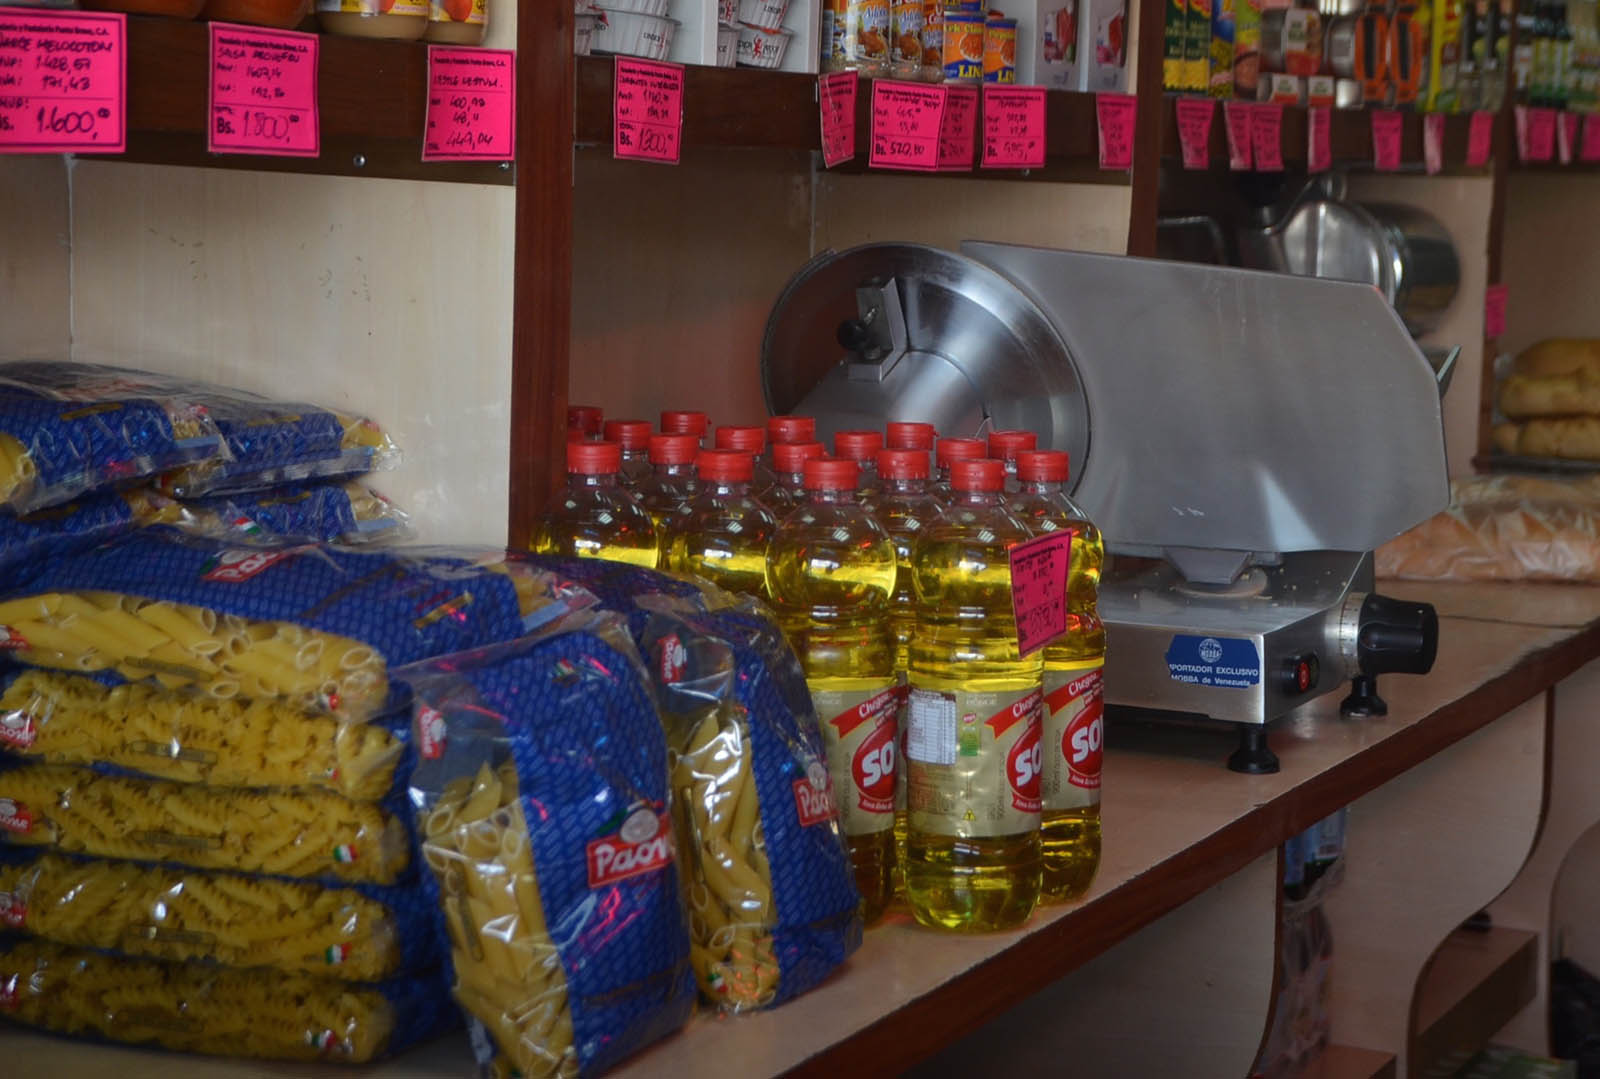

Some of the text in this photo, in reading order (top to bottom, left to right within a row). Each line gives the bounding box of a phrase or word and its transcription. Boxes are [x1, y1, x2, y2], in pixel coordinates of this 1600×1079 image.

[216, 116, 236, 134] Bs.
[1216, 666, 1259, 677] EXCLUSIVO
[1215, 677, 1251, 687] Venezuela
